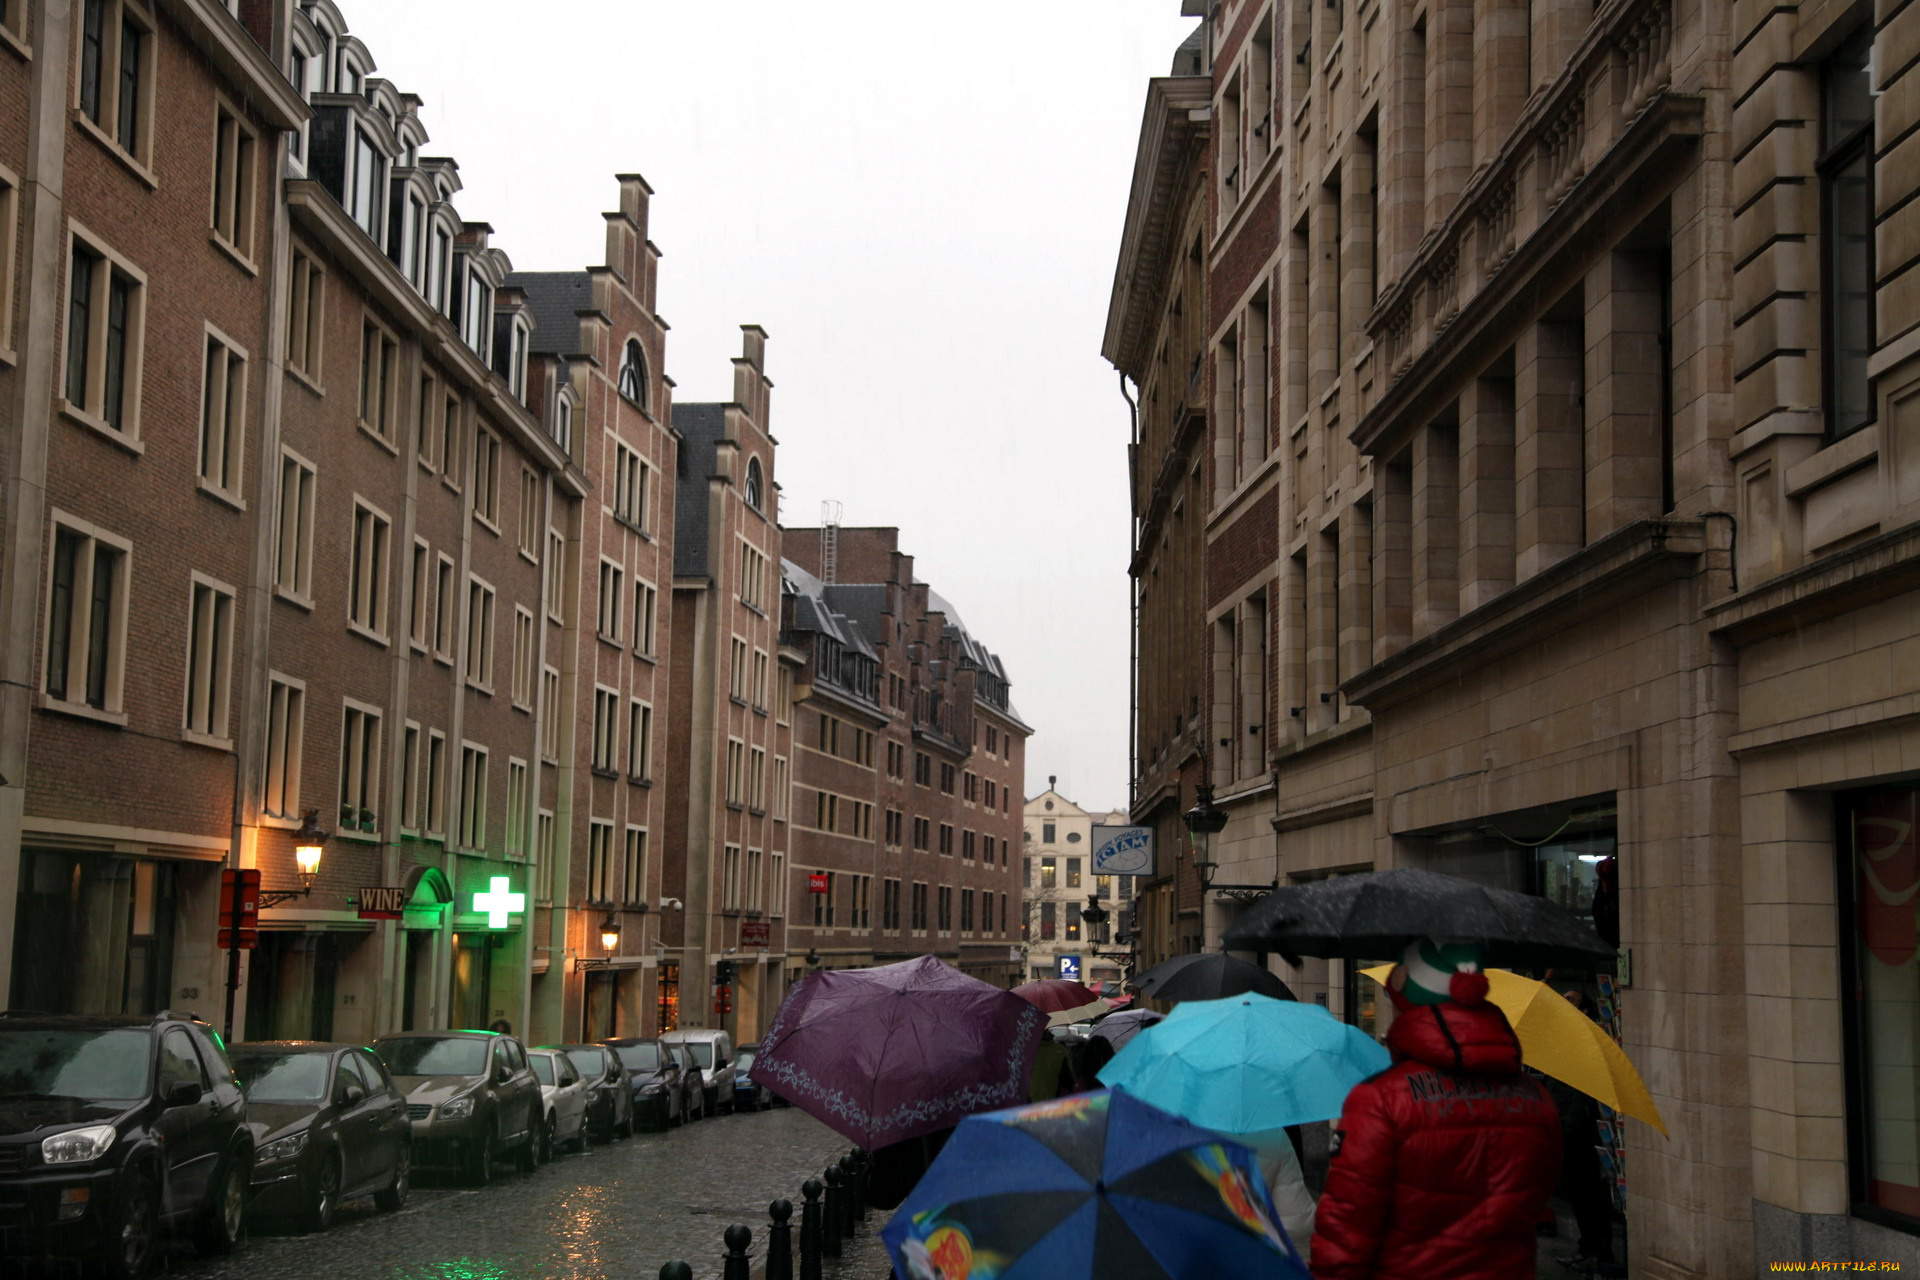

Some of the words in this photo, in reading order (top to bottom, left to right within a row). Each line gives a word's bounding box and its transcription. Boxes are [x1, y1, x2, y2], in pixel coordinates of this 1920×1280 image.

[1114, 829, 1143, 842] VOYAGES
[1098, 836, 1146, 863] ICTAM
[810, 879, 825, 888] ibis
[361, 889, 403, 911] WINE
[1061, 958, 1071, 972] P
[182, 987, 199, 1000] 33
